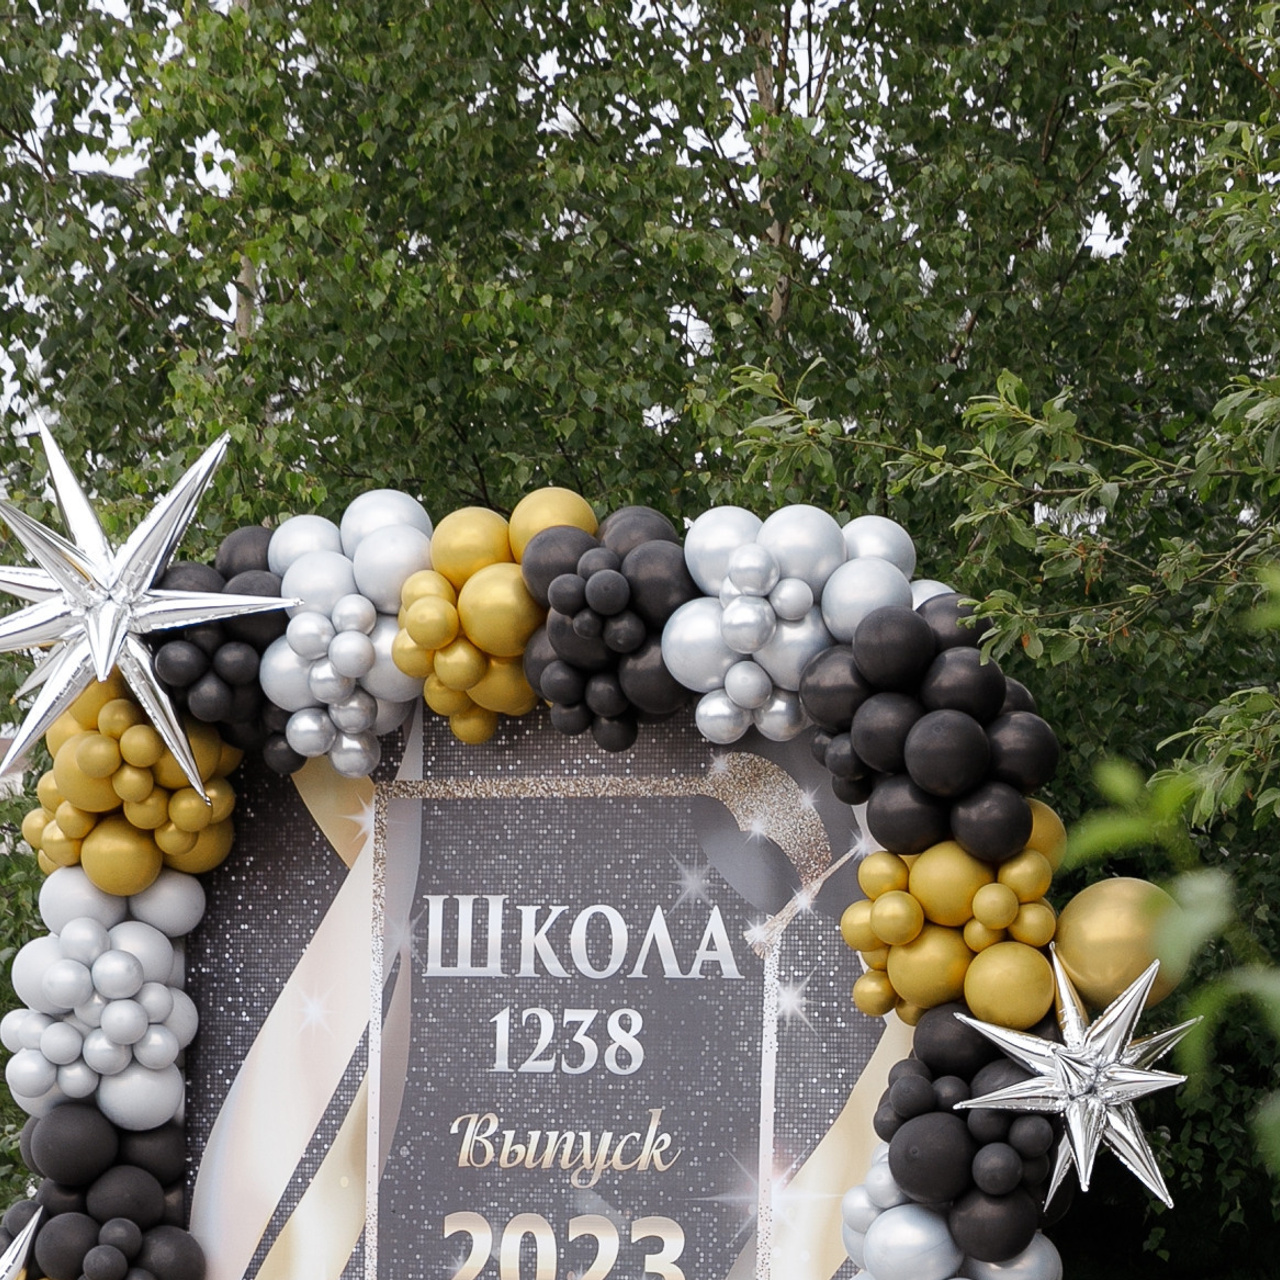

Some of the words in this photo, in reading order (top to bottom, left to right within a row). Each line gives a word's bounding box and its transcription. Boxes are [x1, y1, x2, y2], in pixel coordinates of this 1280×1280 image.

[422, 894, 745, 980] ШКОЛА
[488, 1007, 645, 1076] 1238
[449, 1108, 682, 1189] Выпуск
